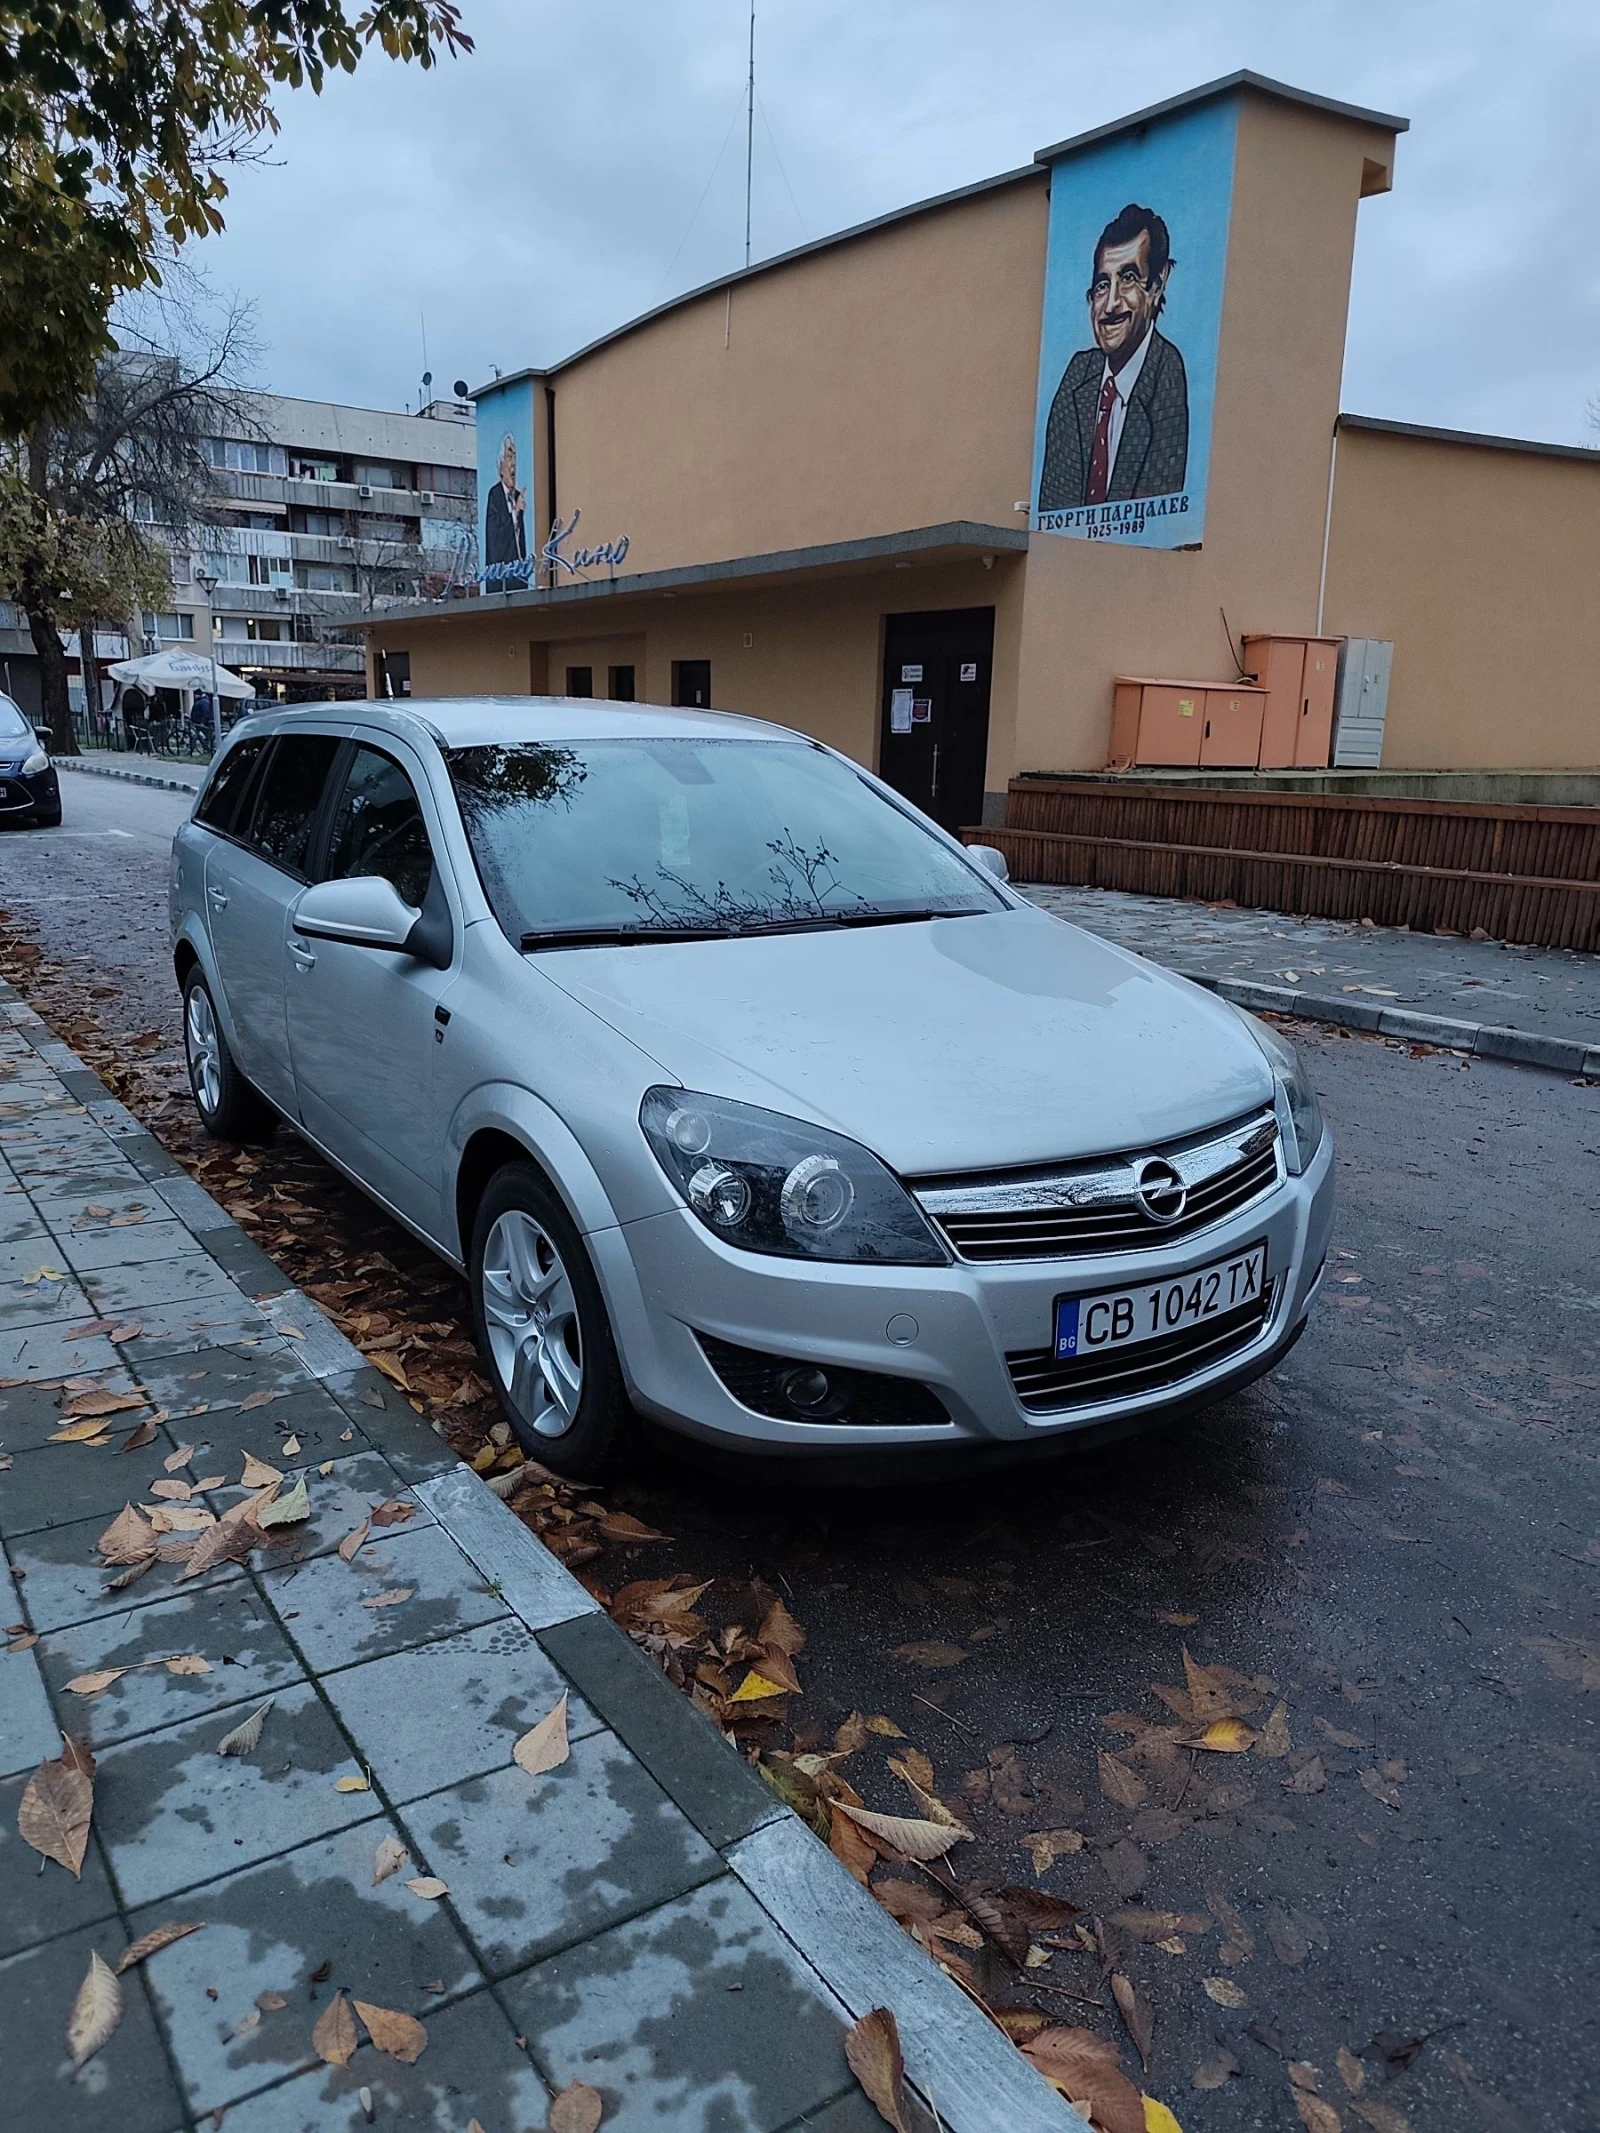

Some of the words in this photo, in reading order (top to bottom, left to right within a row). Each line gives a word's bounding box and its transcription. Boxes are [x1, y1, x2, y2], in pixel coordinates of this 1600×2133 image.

[1037, 508, 1096, 531] ГЕОРГИ
[1100, 495, 1189, 522] ПАРЦАЛЕВ
[1087, 520, 1145, 539] 1925-1989
[541, 508, 630, 575] Кино
[1085, 1297, 1134, 1345] CB
[1148, 1272, 1220, 1331] 1042
[1227, 1254, 1259, 1304] TX
[1060, 1336, 1076, 1350] BG
